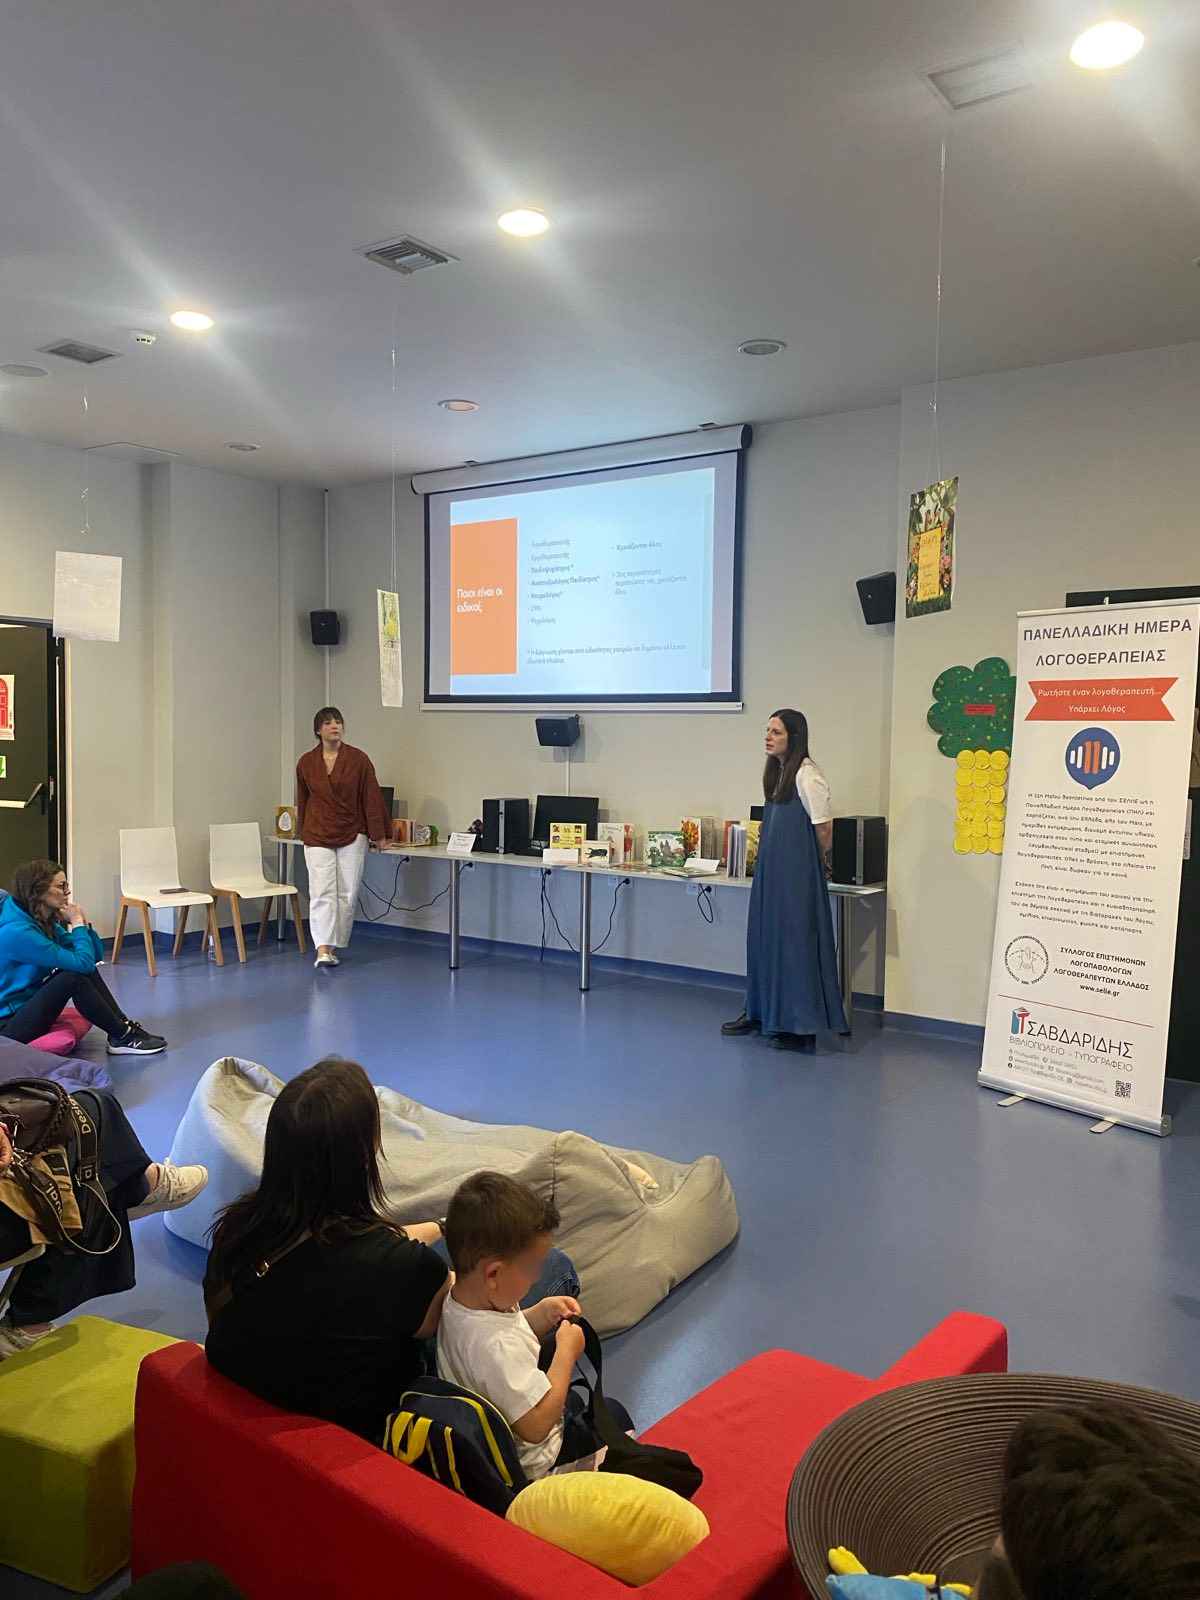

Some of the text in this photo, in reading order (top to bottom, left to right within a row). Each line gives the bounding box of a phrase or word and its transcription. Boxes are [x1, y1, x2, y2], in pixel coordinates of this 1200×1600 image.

[1023, 619, 1192, 641] ΠΑΝΕΛΛΑΔΙΚΗ ΗΜΕΡΑ
[1035, 649, 1166, 667] ΛΟΓΟΘΕΡΑΠΕΙΑΣ
[1100, 704, 1127, 713] Λόγος
[1060, 946, 1146, 967] ΣΥΛΛΟΓΟΣ ΕΠΙΣΤΗΜΟΝΩΝ
[1053, 968, 1150, 991] ΛΟΓΟΘΕΡΑΠΕΥΤΩΝ ΕΛΛΑΔΟΣ
[1080, 984, 1120, 997] www.selle.gr
[1075, 1052, 1133, 1073] ΤΥΠΟΓΡΑΦΕΙΟ
